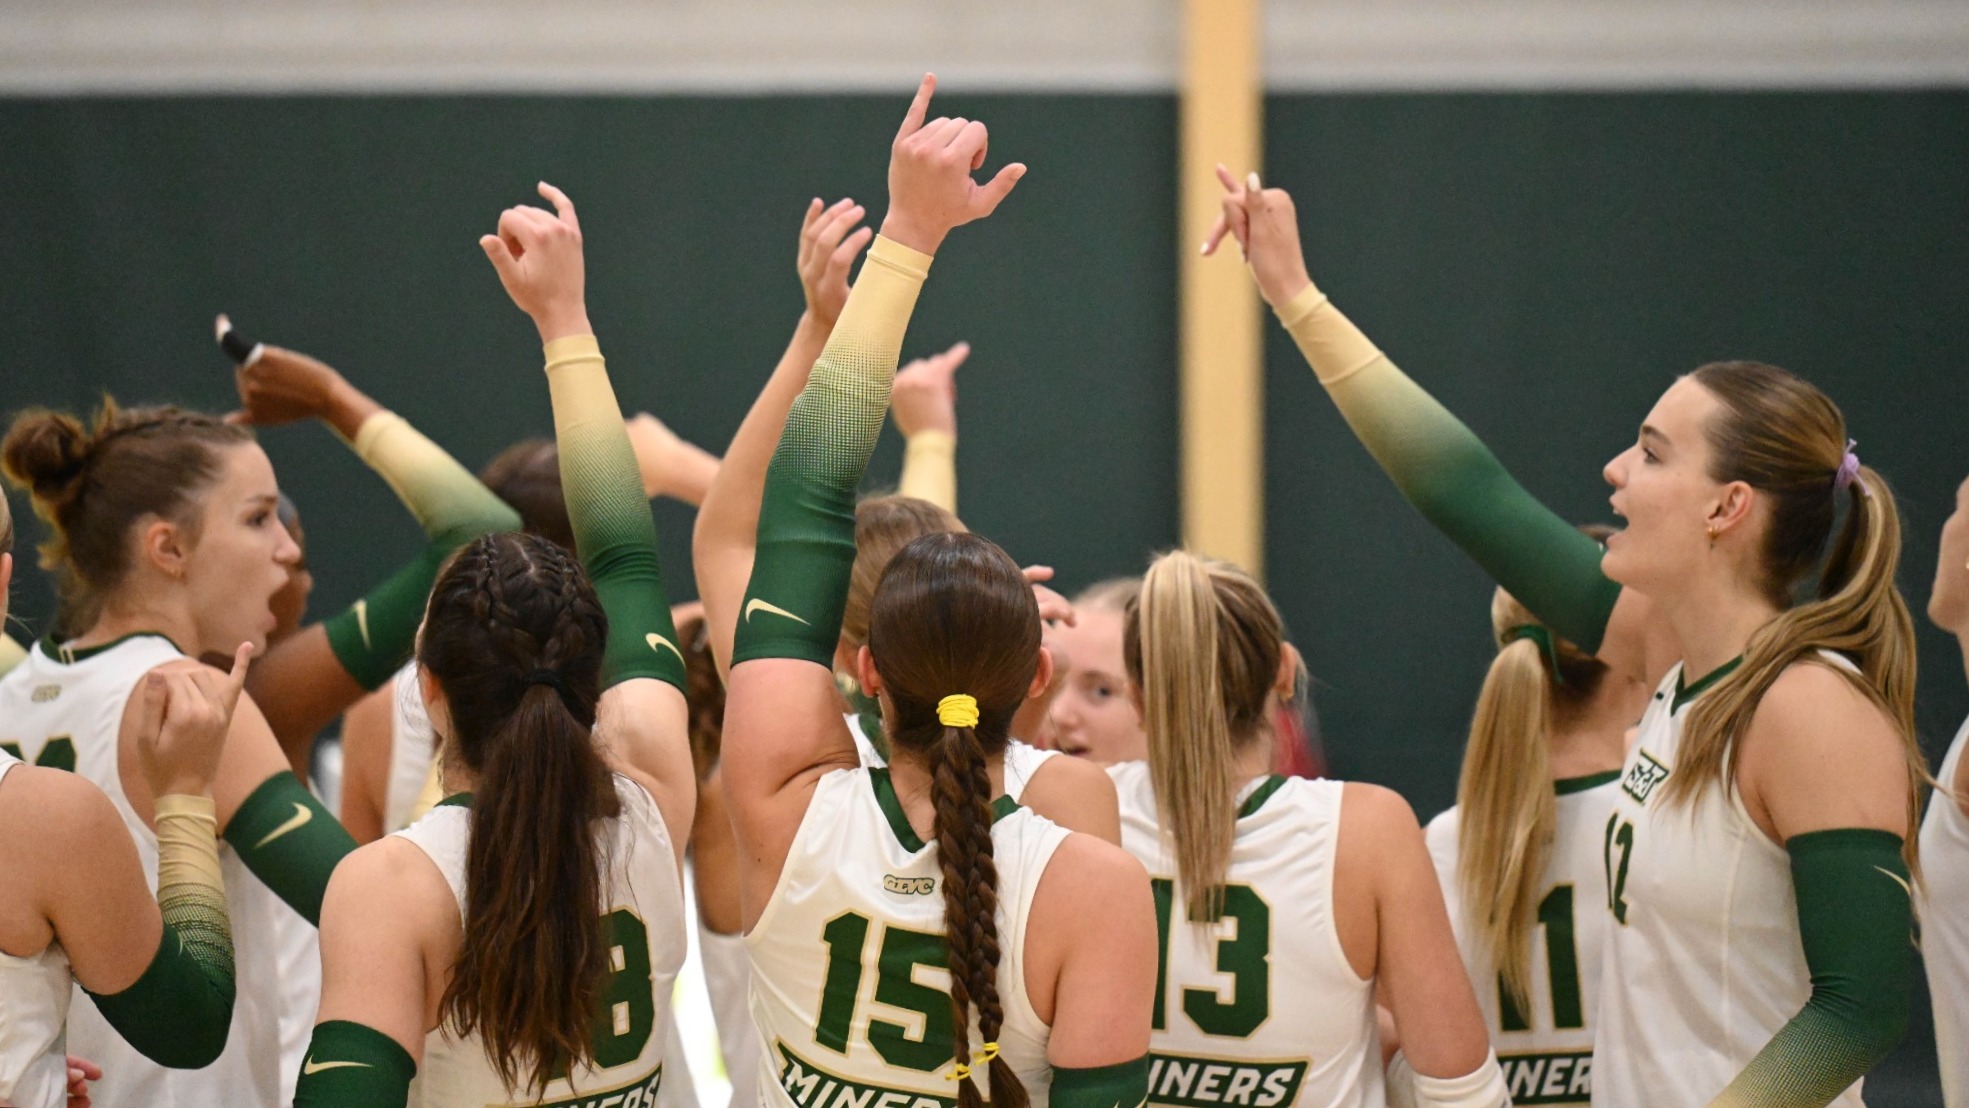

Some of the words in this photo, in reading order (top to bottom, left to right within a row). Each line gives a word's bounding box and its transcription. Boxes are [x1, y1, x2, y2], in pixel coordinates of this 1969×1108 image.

[1604, 812, 1634, 926] 12
[572, 905, 656, 1076] 8
[813, 909, 956, 1073] 15
[1149, 1058, 1297, 1107] INERS
[1502, 1056, 1592, 1098] NER
